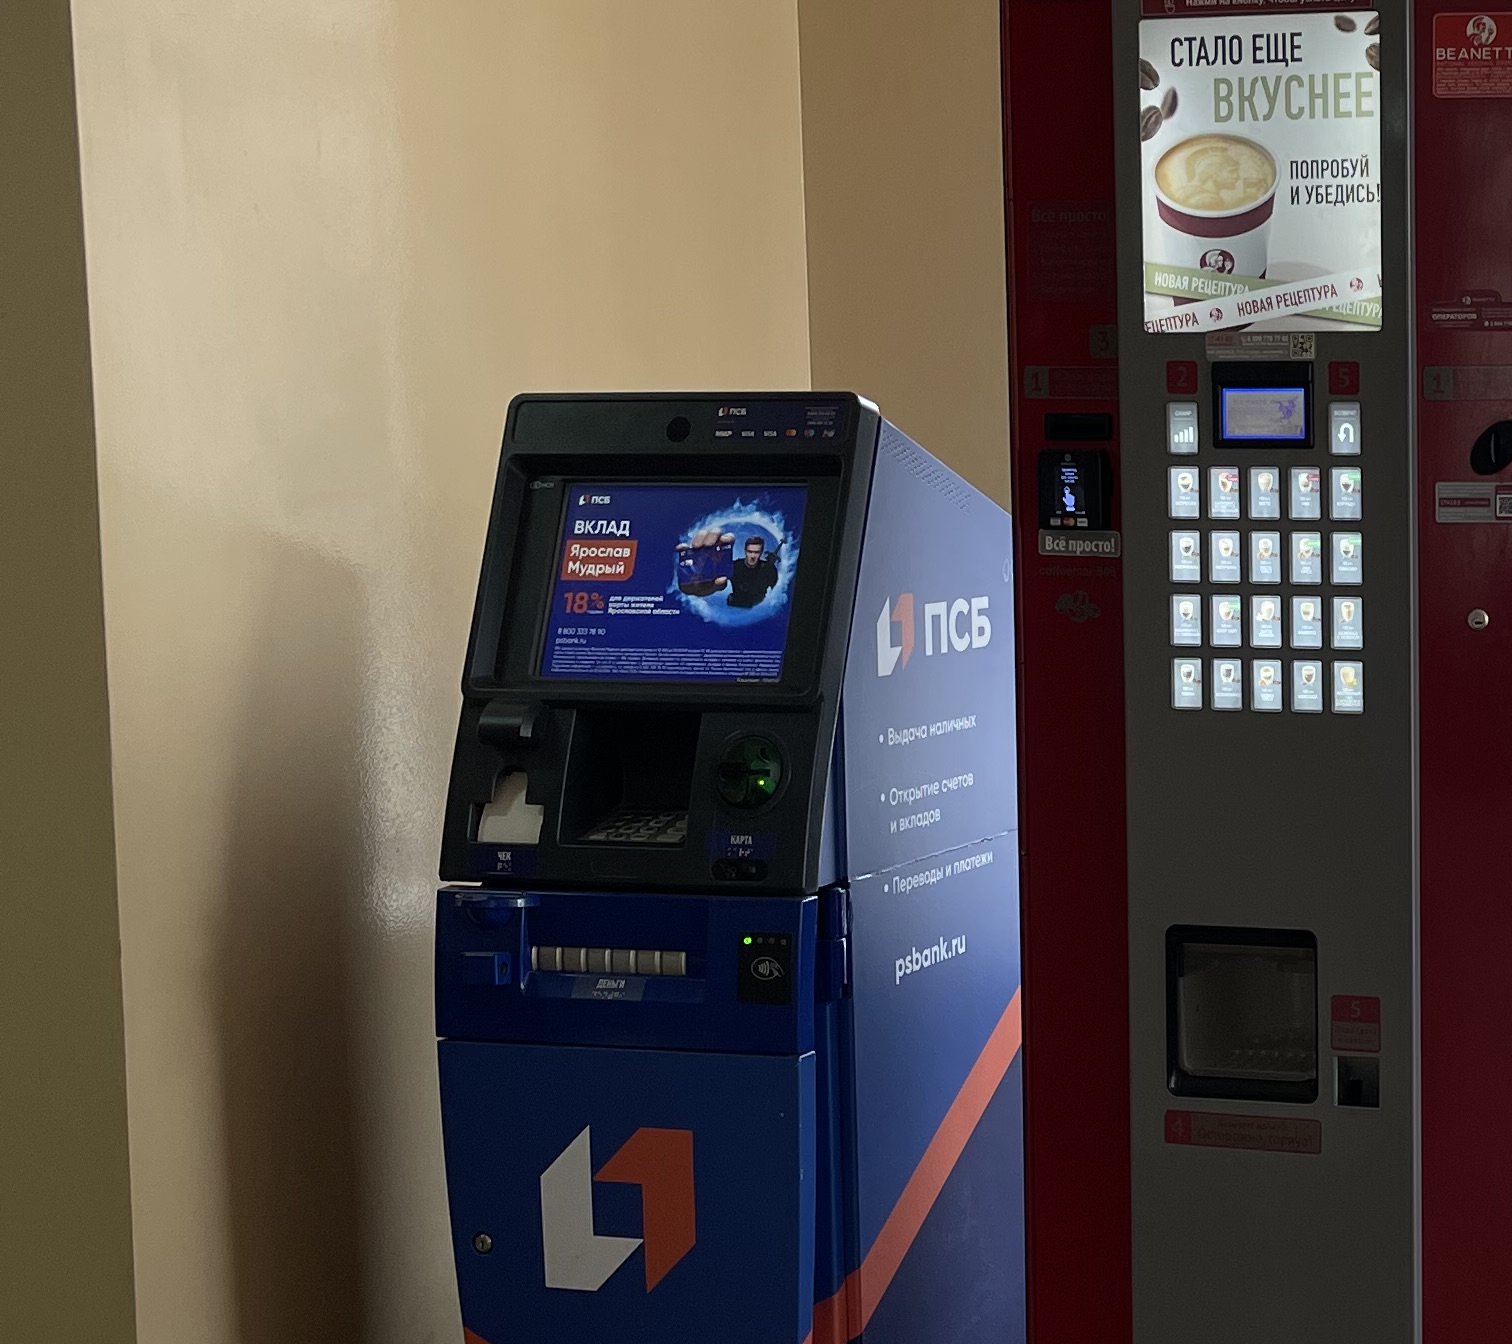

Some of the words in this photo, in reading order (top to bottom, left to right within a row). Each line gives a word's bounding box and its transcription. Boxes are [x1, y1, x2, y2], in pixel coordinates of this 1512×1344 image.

[1170, 35, 1243, 67] СТАЛО
[1251, 32, 1303, 67] ЕЩЕ
[1213, 70, 1375, 124] ВКУСНЕЕ
[1288, 156, 1370, 180] ПОПРОБУЙ
[1289, 186, 1300, 206] И
[1304, 181, 1382, 206] УБЕДИСЬ!
[1154, 271, 1189, 291] НОВАЯ
[1237, 297, 1273, 317] НОВАЯ
[1277, 284, 1338, 309] РЕЦЕПТУРА
[1175, 367, 1188, 388] 2
[1337, 367, 1350, 388] 5
[1432, 372, 1444, 394] 1
[729, 407, 747, 416] ПСБ
[591, 495, 611, 504] ПСБ
[573, 520, 631, 537] ВКЛАД
[569, 544, 631, 560] Ярослав
[1045, 534, 1067, 551] Всё
[1068, 537, 1115, 554] просто!
[567, 560, 625, 577] Мудрый
[563, 591, 605, 614] 18%
[924, 596, 992, 656] ПСБ
[887, 723, 928, 746] Выдача
[929, 714, 977, 737] наличных
[889, 780, 940, 806] Открытие
[941, 772, 974, 794] счетов
[890, 820, 898, 834] и
[899, 807, 941, 831] вкладов
[730, 834, 753, 845] КАРТА
[497, 850, 512, 862] ЧЕК
[892, 867, 944, 895] Переводы
[945, 863, 952, 877] и
[953, 850, 993, 875] платежи
[895, 933, 967, 985] psbank.ru
[596, 978, 627, 989] ДЕНЬГИ
[1350, 1000, 1361, 1018] 5
